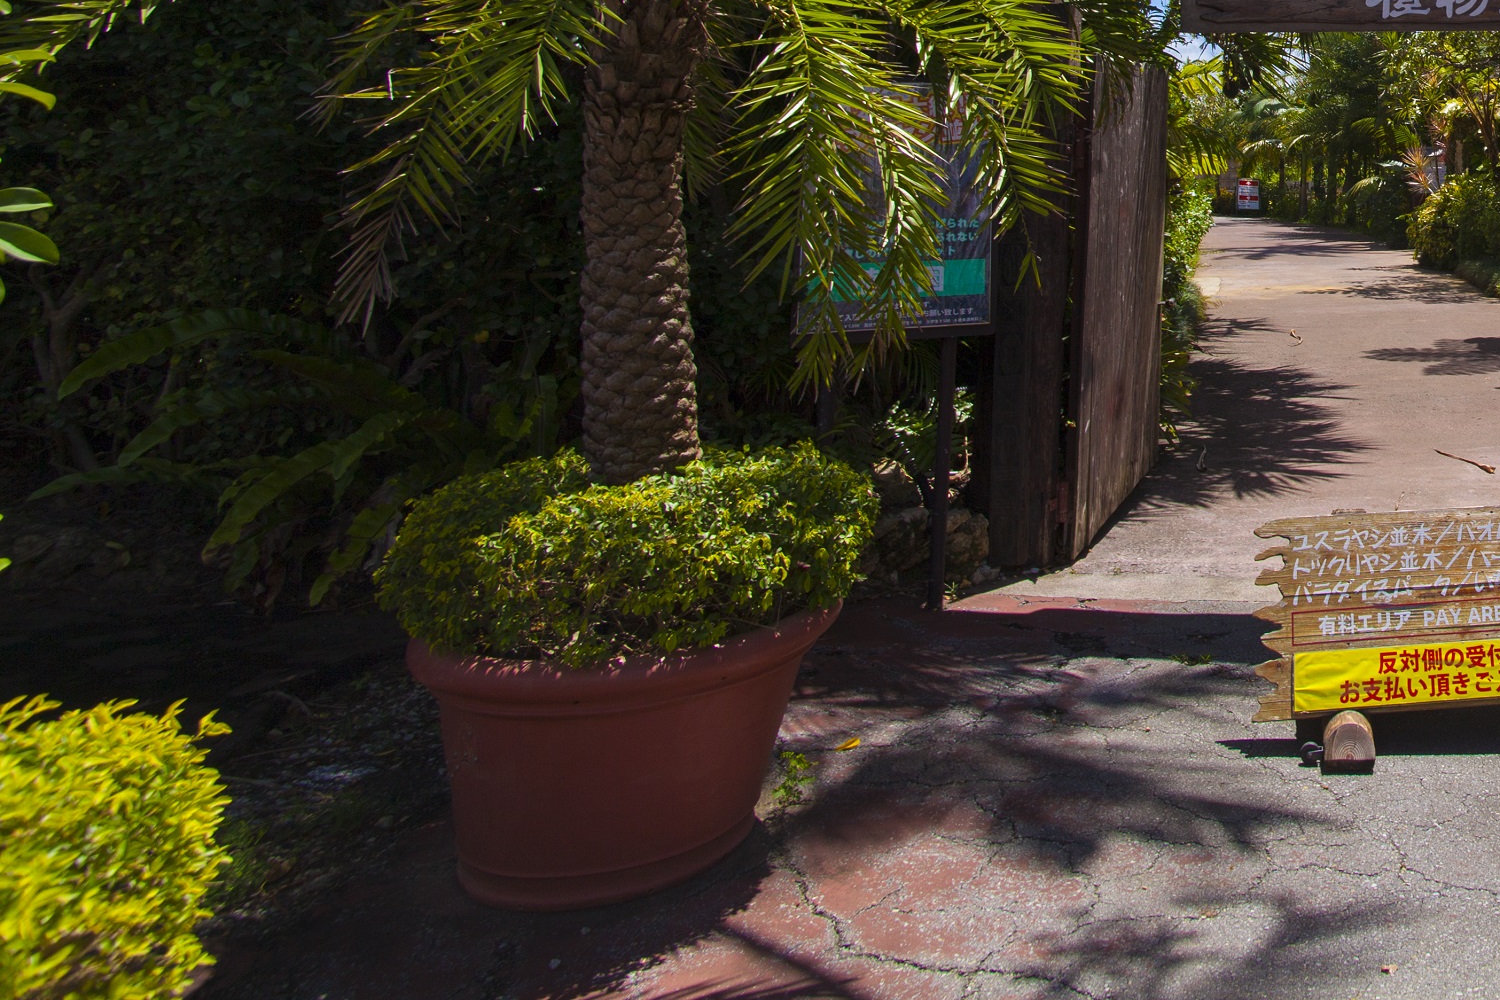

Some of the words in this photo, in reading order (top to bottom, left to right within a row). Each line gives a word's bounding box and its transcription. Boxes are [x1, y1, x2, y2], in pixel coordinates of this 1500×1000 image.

[1318, 610, 1411, 637] 有料エリア
[1423, 607, 1462, 626] PAY
